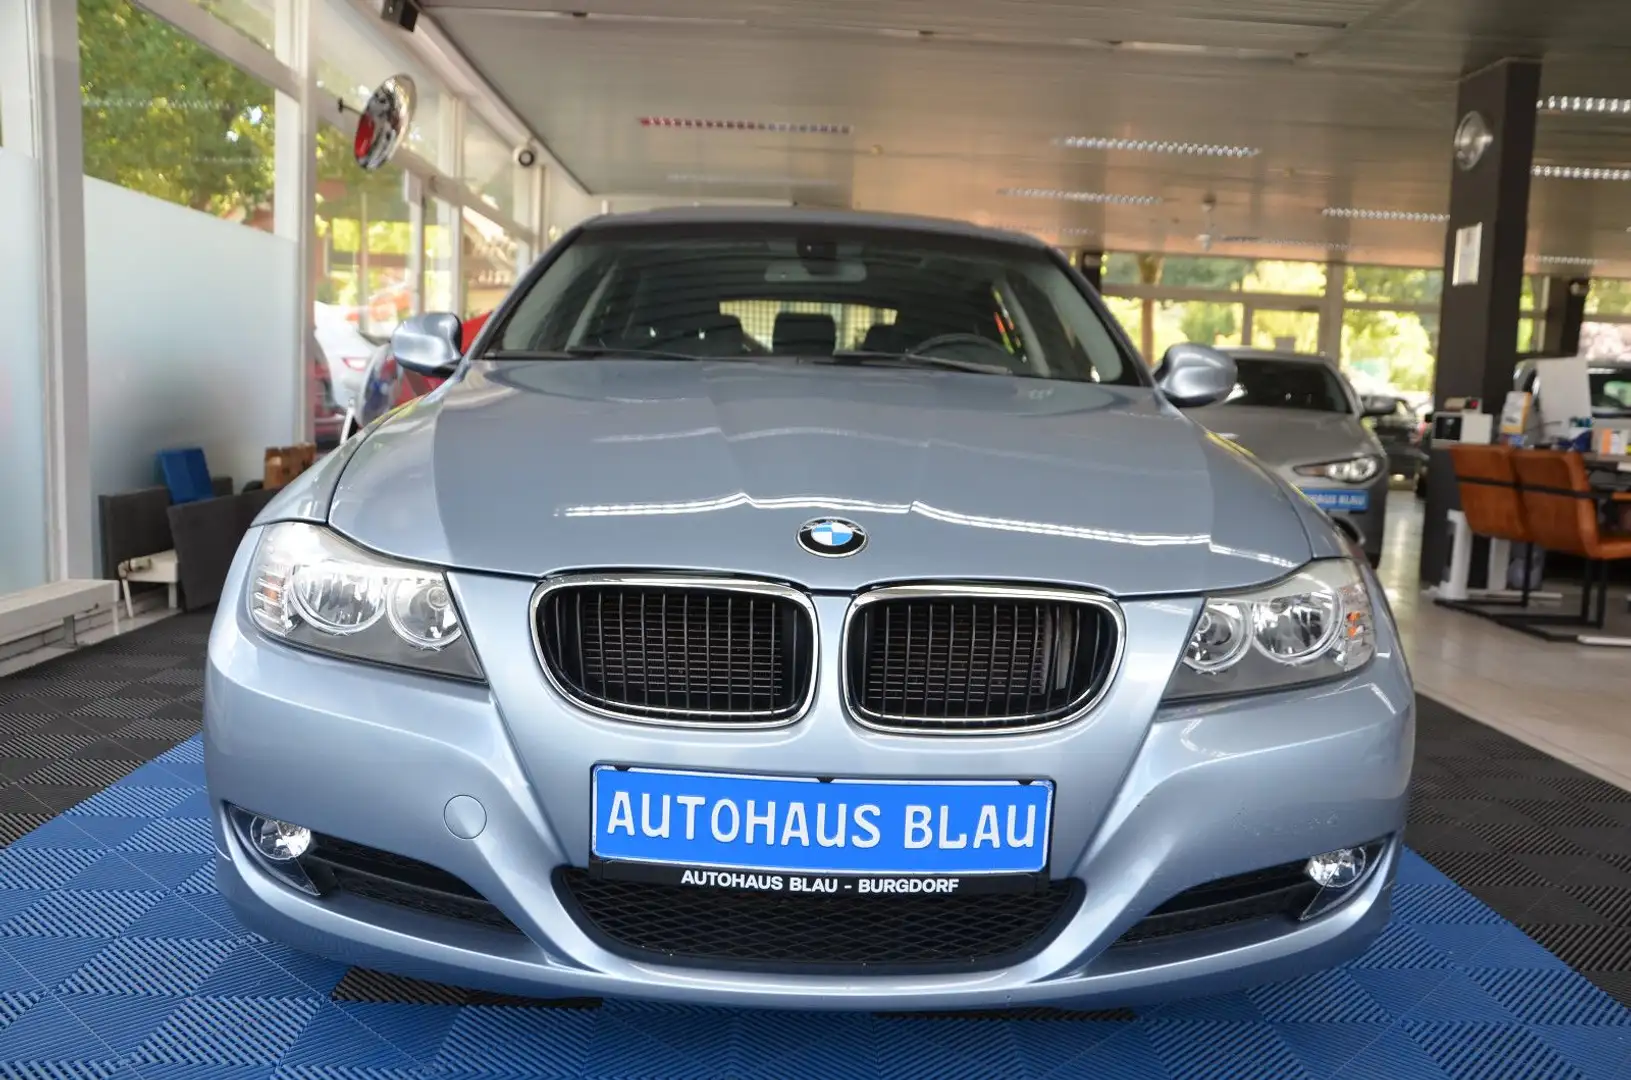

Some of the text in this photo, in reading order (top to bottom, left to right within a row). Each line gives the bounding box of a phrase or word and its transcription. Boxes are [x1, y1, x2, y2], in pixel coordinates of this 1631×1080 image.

[607, 791, 1036, 849] AUTOHAUS BLAU
[681, 870, 783, 890] AUTOHAUS
[790, 876, 838, 892] BLAU
[859, 878, 959, 893] BURGDORF
